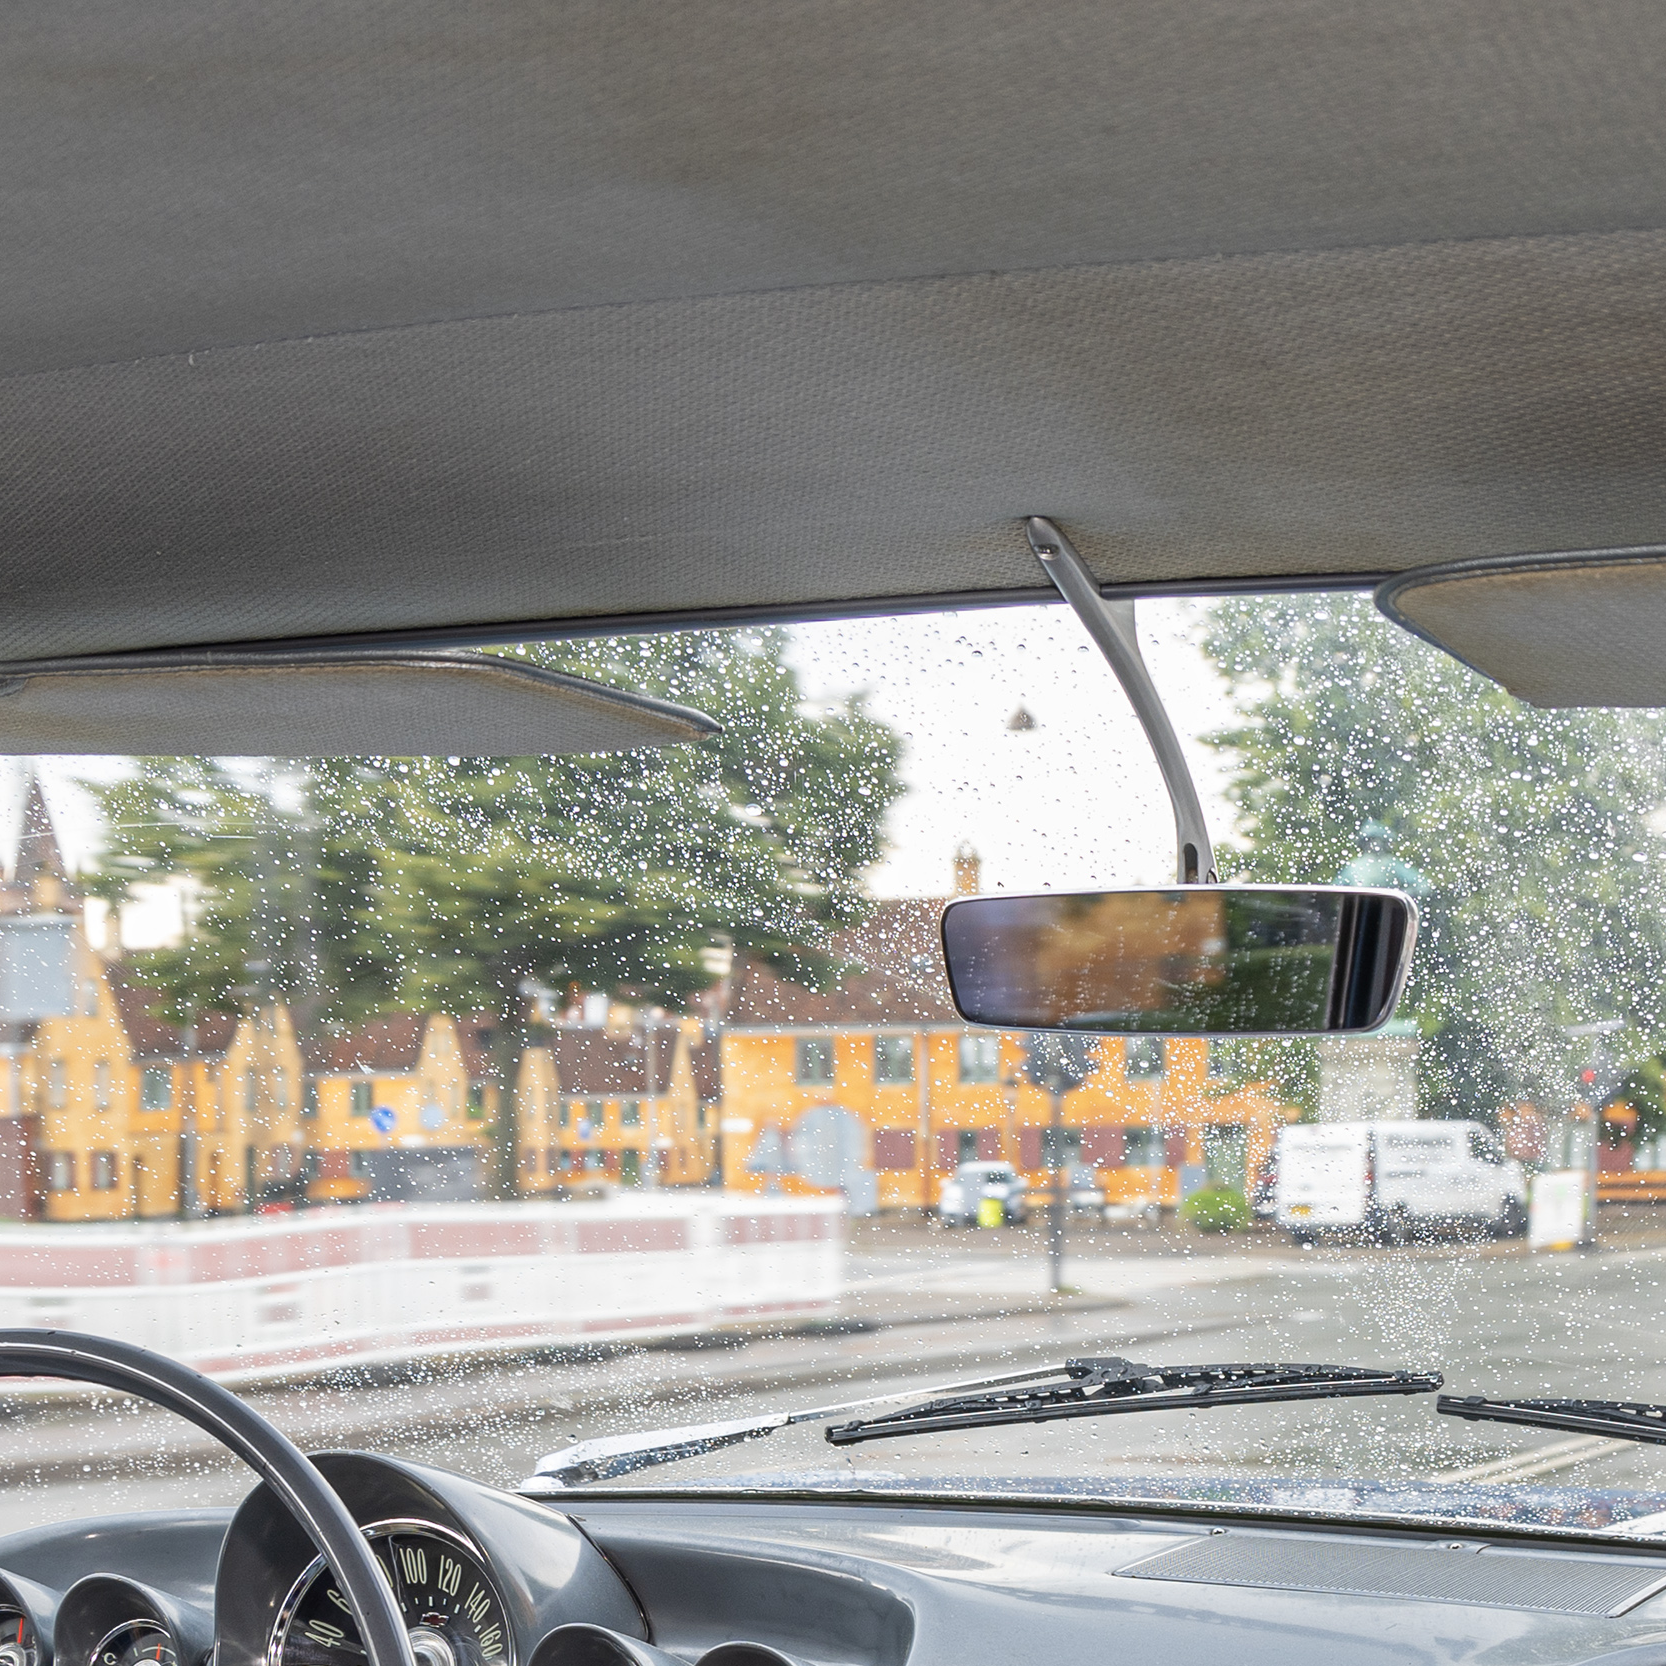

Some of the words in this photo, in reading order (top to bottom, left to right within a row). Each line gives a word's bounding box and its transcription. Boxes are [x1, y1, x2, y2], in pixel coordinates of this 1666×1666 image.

[399, 1548, 427, 1585] 100
[438, 1554, 462, 1596] 120
[326, 1589, 353, 1615] 6
[464, 1582, 491, 1623] 140
[304, 1619, 345, 1649] 40
[479, 1622, 503, 1658] 160
[103, 1652, 117, 1666] C
